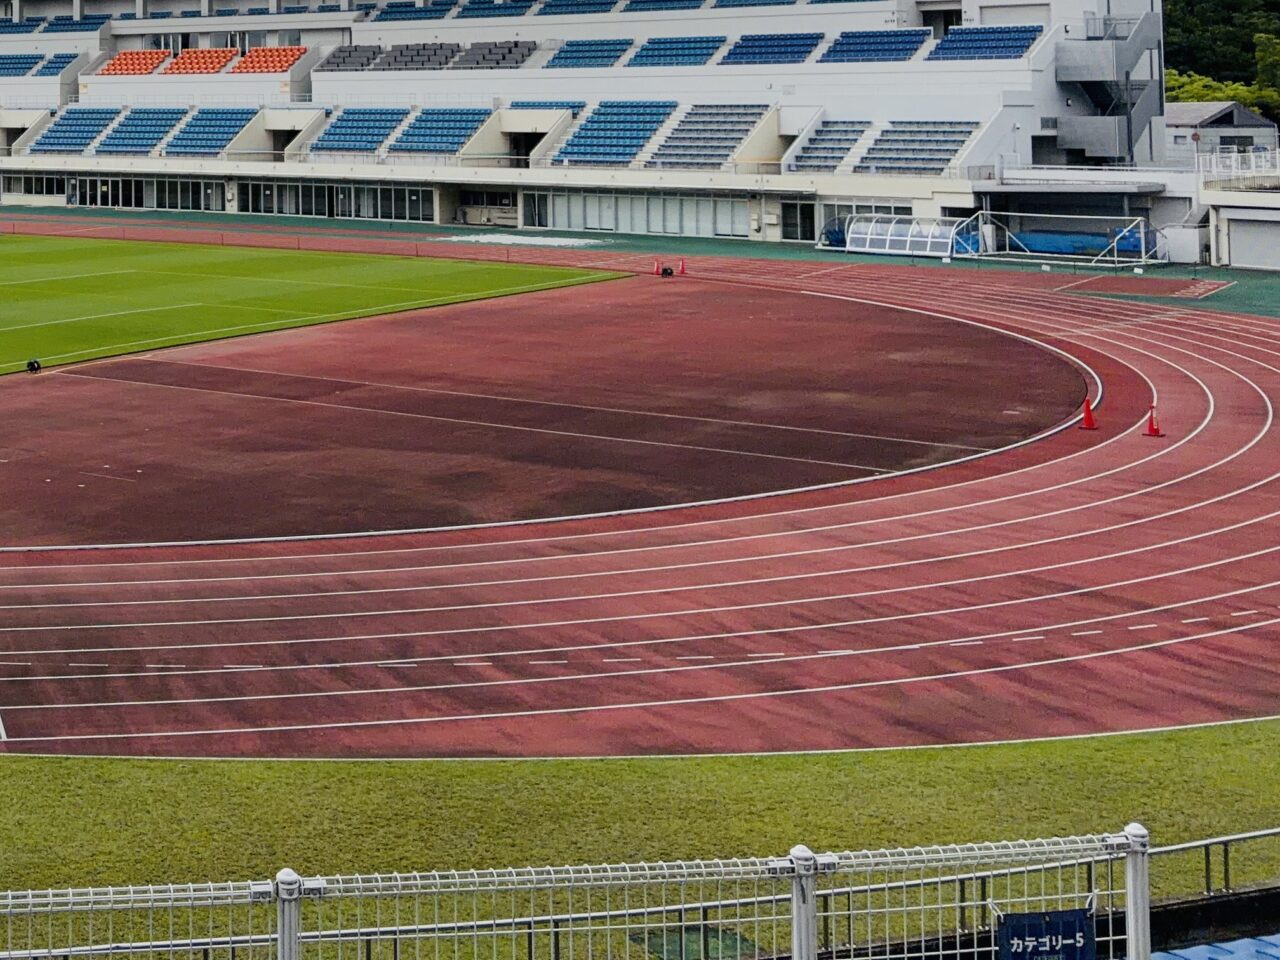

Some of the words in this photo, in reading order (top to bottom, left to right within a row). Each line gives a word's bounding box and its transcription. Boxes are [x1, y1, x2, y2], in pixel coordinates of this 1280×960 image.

[1009, 932, 1085, 953] カテゴリー5
